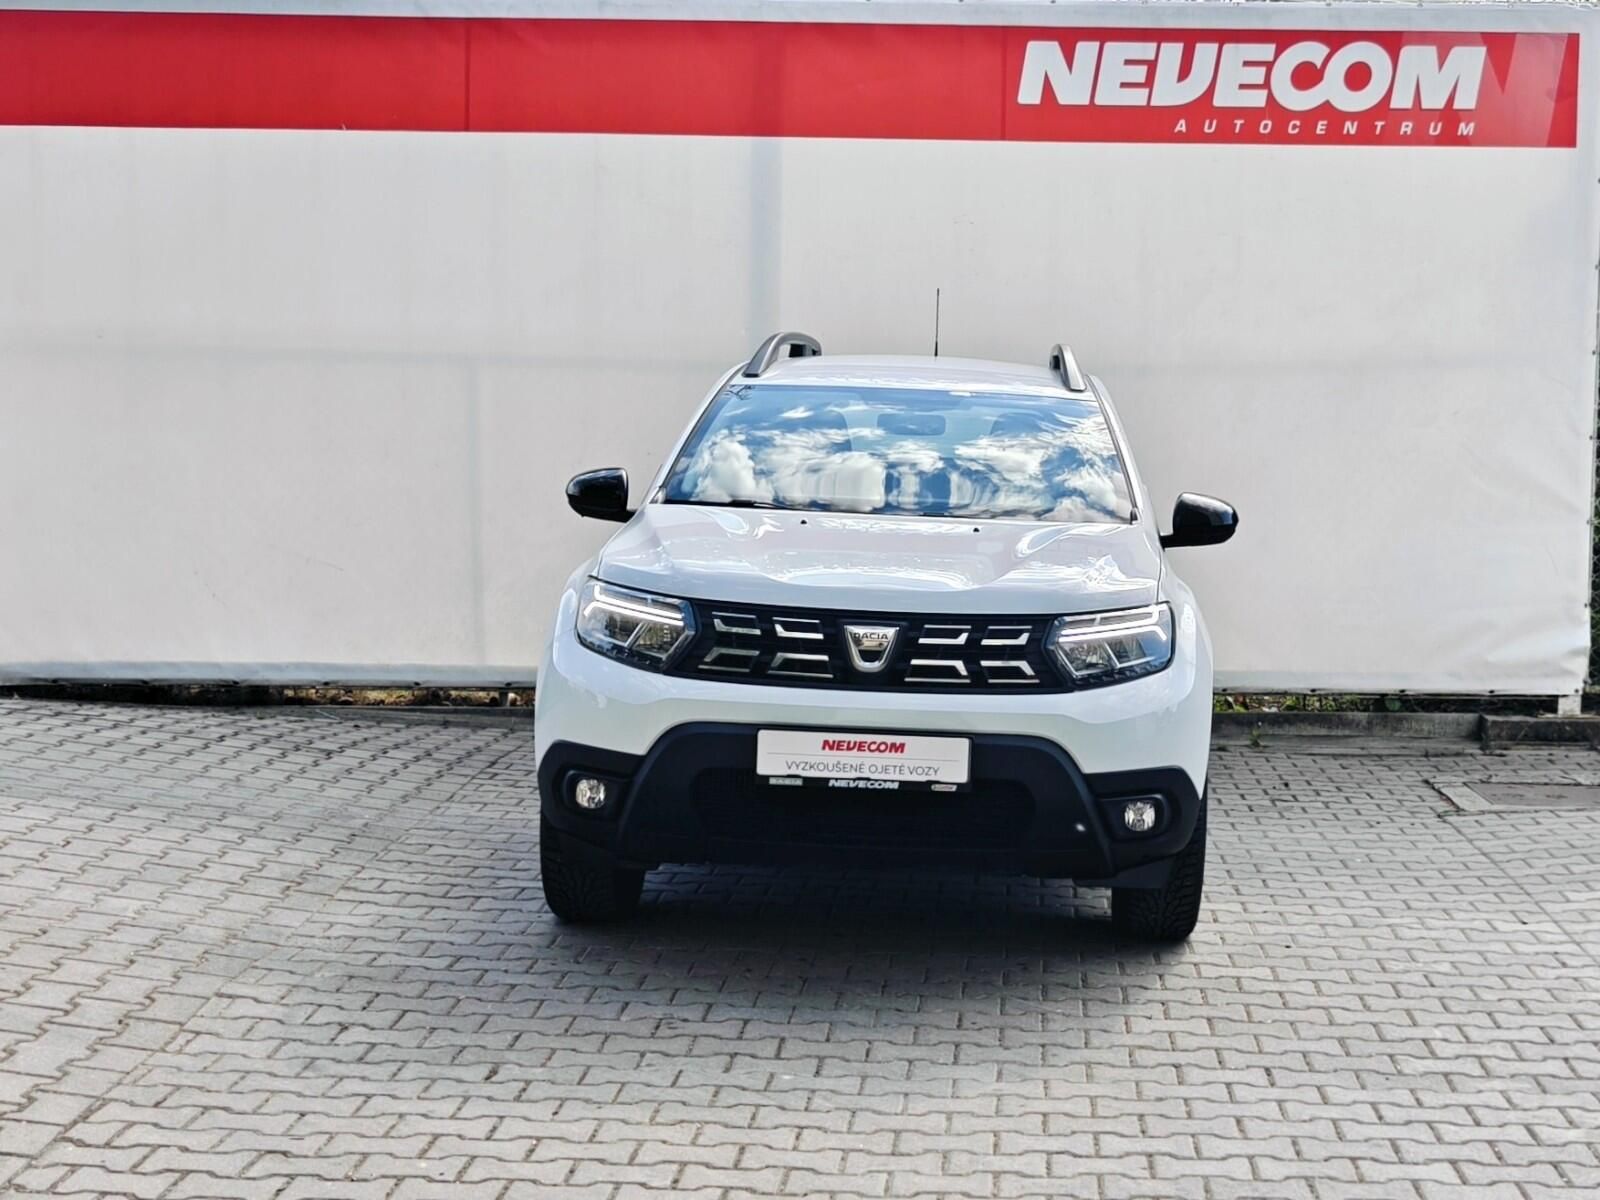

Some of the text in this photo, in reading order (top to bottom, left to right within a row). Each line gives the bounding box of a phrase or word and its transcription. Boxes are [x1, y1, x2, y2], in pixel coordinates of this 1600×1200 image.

[1017, 40, 1487, 112] NEVECOM
[1174, 118, 1476, 136] AUTOCENTRUM
[853, 632, 888, 640] DACIA
[821, 739, 906, 754] NEVECOM
[786, 760, 940, 777] VYZKOUŠENÉ OJETÉ VOZY
[828, 779, 900, 790] NEVECOM
